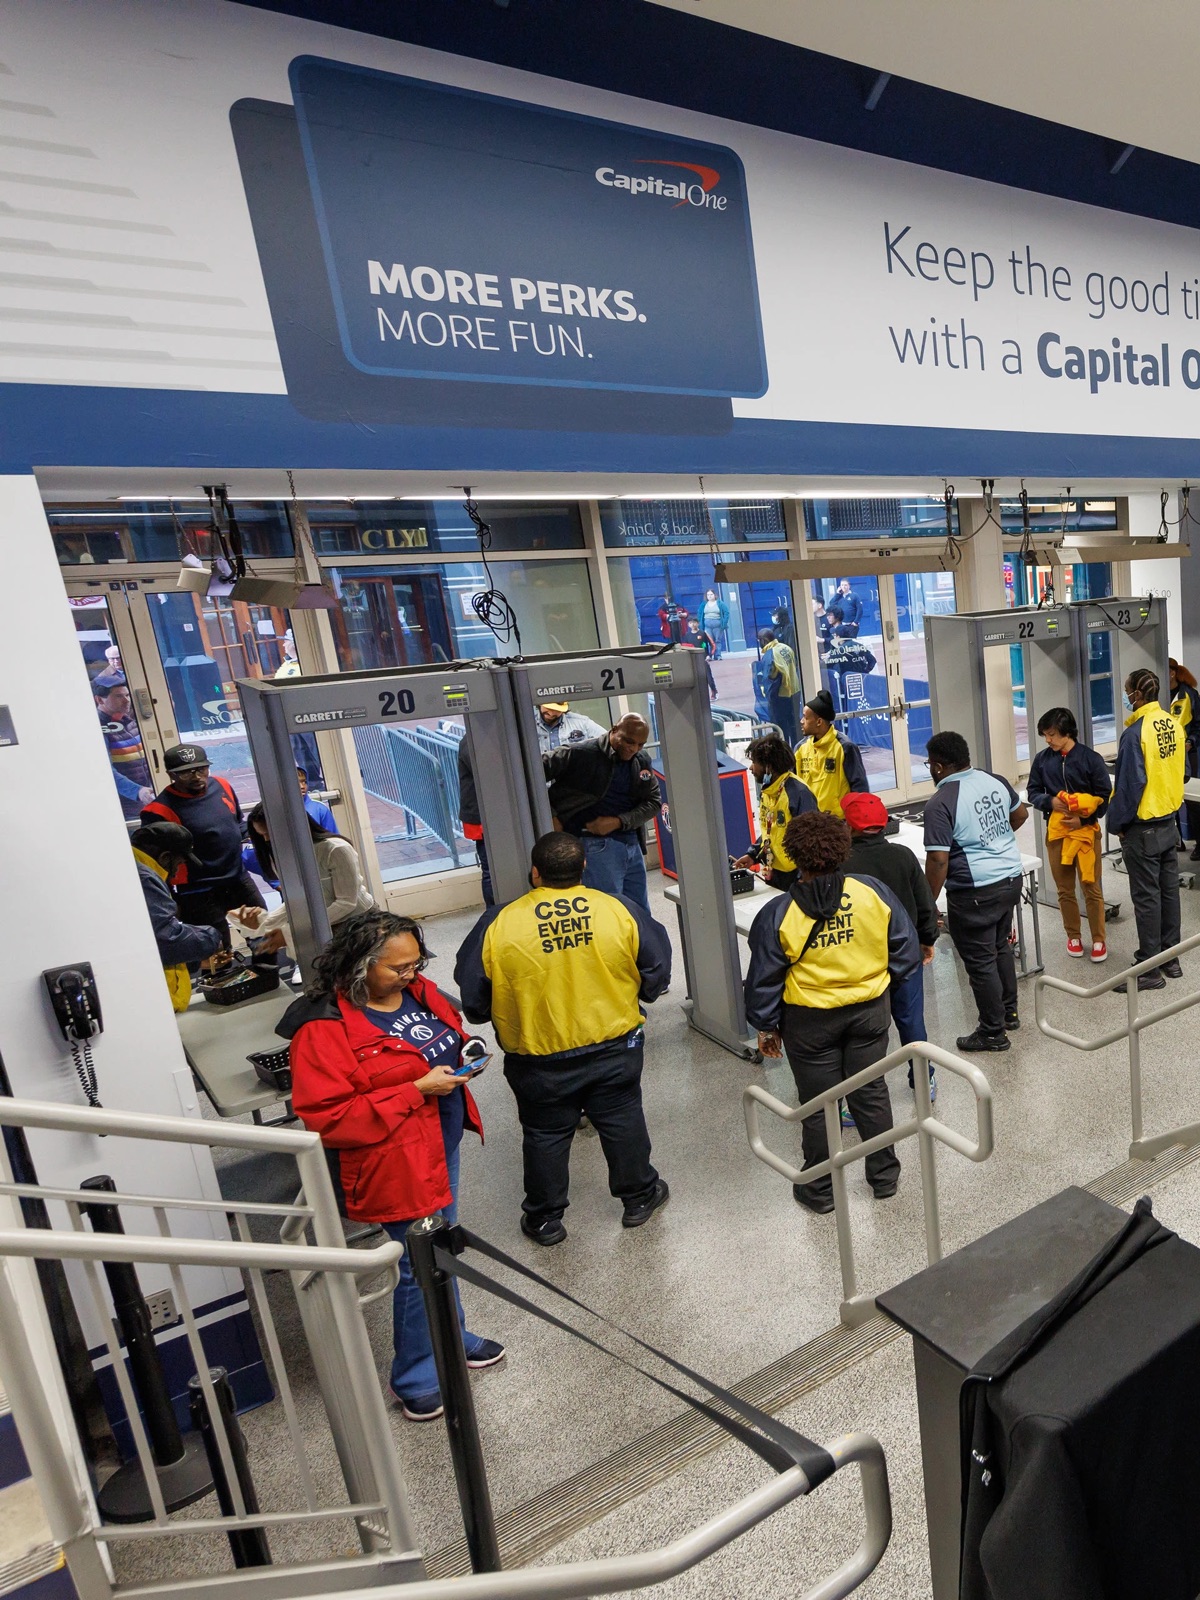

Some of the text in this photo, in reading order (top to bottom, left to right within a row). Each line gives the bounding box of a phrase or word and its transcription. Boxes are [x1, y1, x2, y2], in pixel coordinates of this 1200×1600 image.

[883, 221, 995, 302] Keep
[1008, 244, 1072, 302] the
[1085, 270, 1170, 320] good
[367, 259, 648, 323] MORE PERKS.
[376, 307, 594, 359] MORE FUN.
[888, 316, 985, 372] with
[1001, 338, 1023, 375] a
[1036, 330, 1171, 395] Capital
[1117, 609, 1131, 626] 23
[984, 632, 1005, 641] GARRETT
[1018, 621, 1035, 639] 22
[536, 684, 575, 697] GARRETT
[600, 667, 625, 691] 21
[378, 689, 416, 717] 20
[294, 710, 344, 724] GARRETT
[1153, 717, 1175, 732] CSC
[974, 790, 1002, 815] CSC
[978, 805, 1007, 832] EVENT
[534, 896, 590, 920] CSC
[537, 915, 592, 938] EVENT
[541, 931, 594, 954] STAFF
